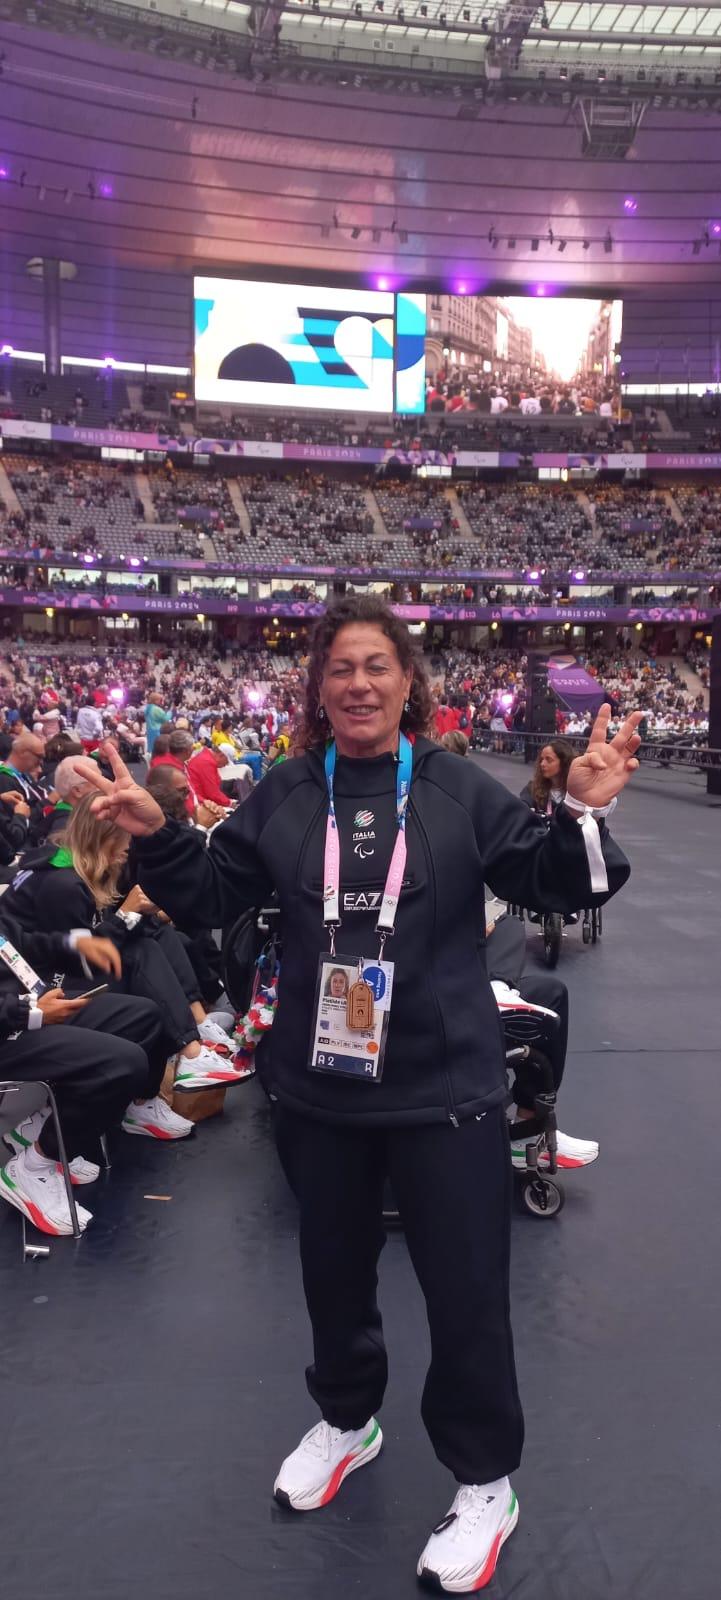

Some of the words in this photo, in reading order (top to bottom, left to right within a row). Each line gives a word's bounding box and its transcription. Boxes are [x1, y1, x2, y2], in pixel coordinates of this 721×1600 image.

[73, 430, 104, 440] PARIS
[107, 432, 136, 443] 2024
[303, 447, 332, 457] PARIS
[145, 600, 172, 609] PARIS
[174, 601, 199, 610] 2024
[556, 609, 581, 618] PARIS
[583, 610, 607, 618] 2024
[352, 830, 376, 839] ITALIA
[344, 892, 382, 906] EA7
[365, 1062, 373, 1073] R
